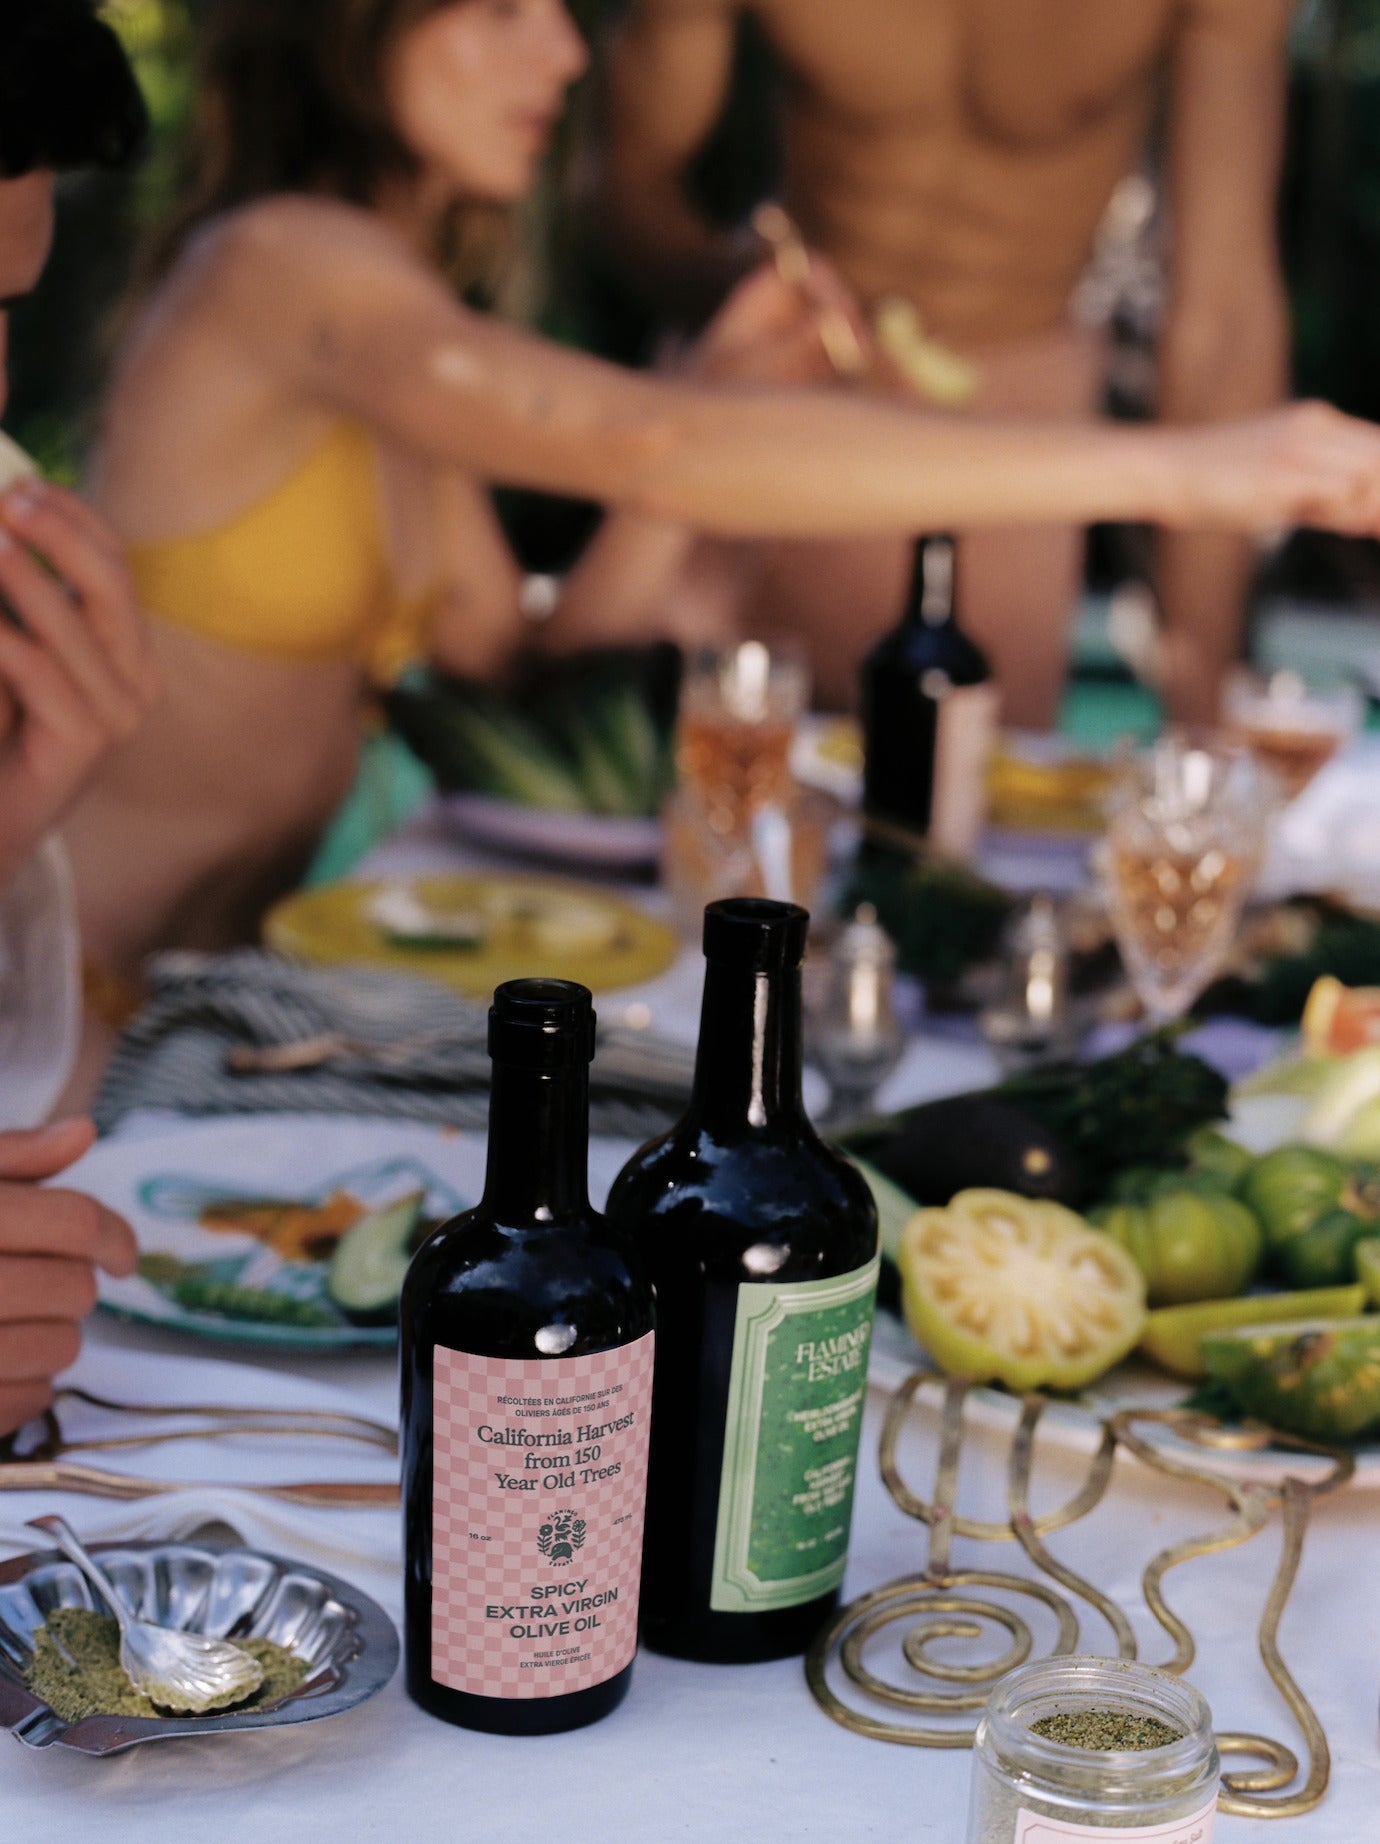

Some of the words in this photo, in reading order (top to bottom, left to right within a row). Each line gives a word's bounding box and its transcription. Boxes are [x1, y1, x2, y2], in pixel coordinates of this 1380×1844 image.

[497, 1395, 542, 1406] RÉCOLTÉES
[543, 1398, 554, 1406] EN
[555, 1392, 596, 1405] CALIFORNIE
[597, 1388, 611, 1399] SUR
[611, 1384, 623, 1394] DES
[515, 1409, 550, 1417] OLIVIERS
[573, 1406, 582, 1414] DE
[583, 1403, 596, 1412] 150
[596, 1400, 610, 1409] ANS
[477, 1425, 572, 1447] California
[576, 1411, 634, 1443] Harvest
[524, 1452, 570, 1469] from
[574, 1445, 601, 1465] 150
[494, 1473, 538, 1491] Year
[543, 1471, 575, 1489] Old
[579, 1461, 621, 1484] Trees
[530, 1579, 589, 1600] SPICY
[486, 1604, 558, 1619] EXTRA
[561, 1587, 618, 1615] VIRGIN
[509, 1621, 570, 1639] OLIVE
[574, 1614, 601, 1632] OIL
[533, 1650, 554, 1659] HUILE
[544, 1657, 569, 1666] VIERGE
[569, 1653, 591, 1664] ÉPICÉE
